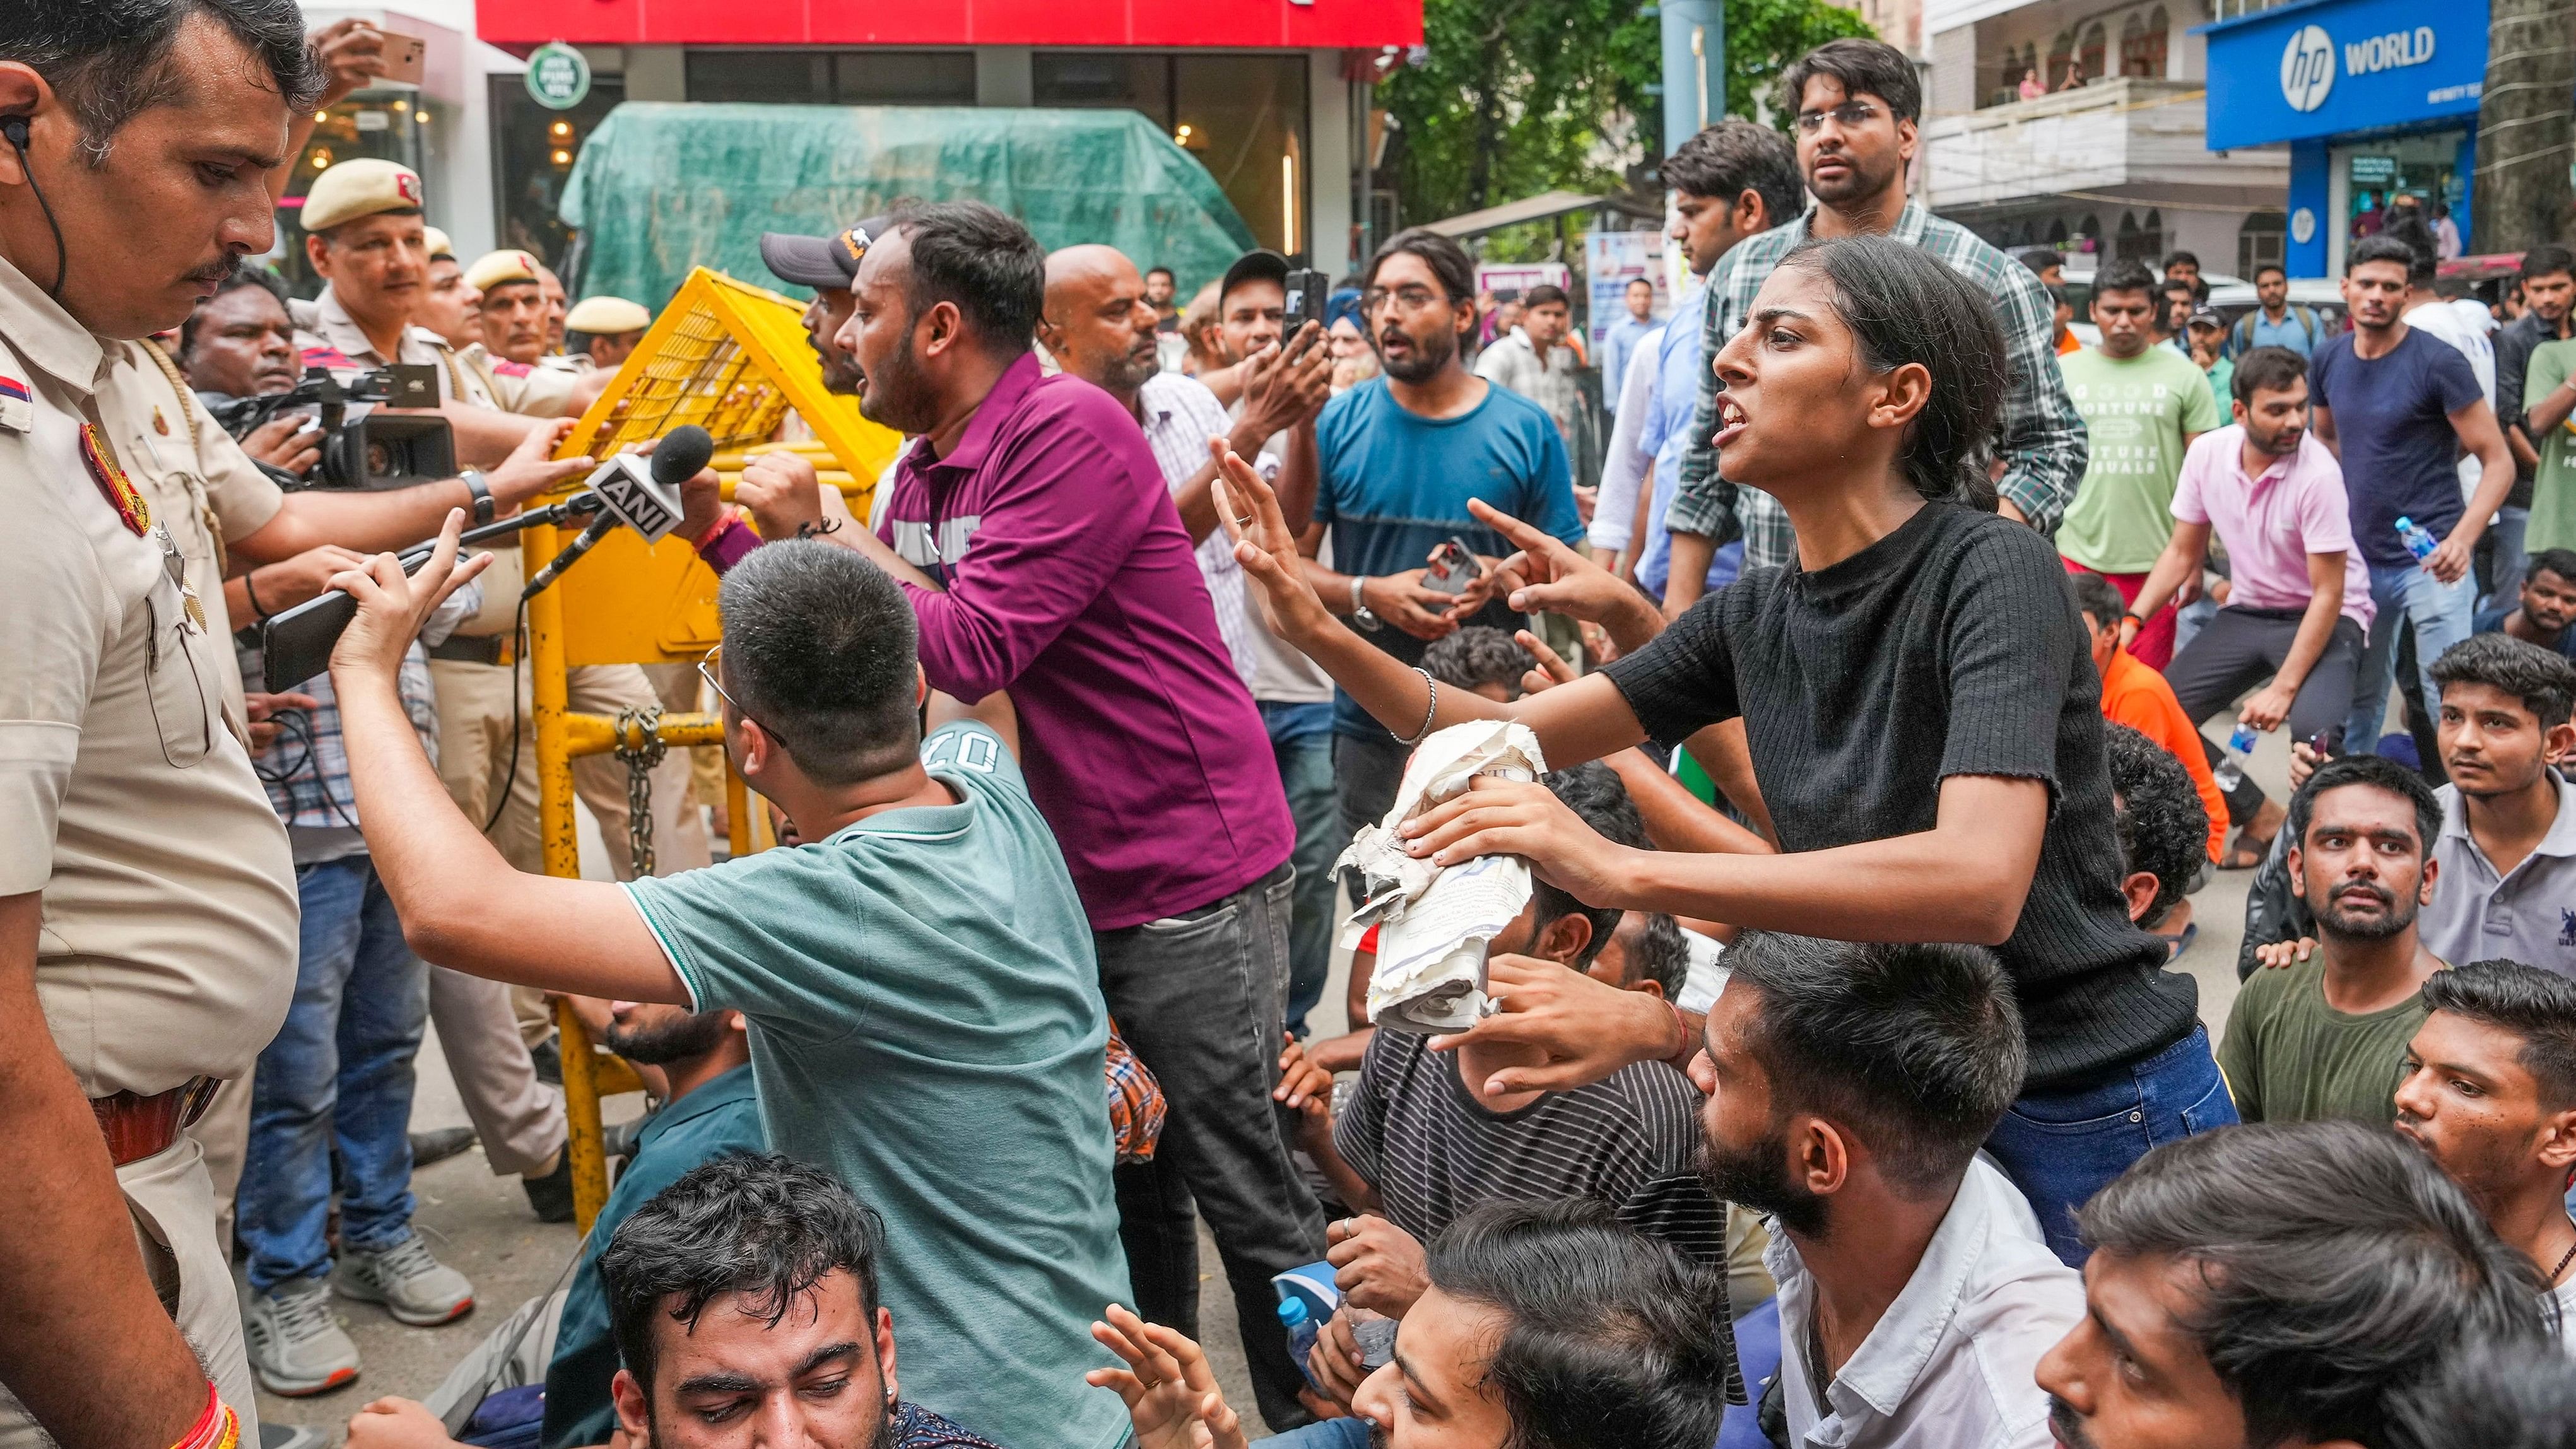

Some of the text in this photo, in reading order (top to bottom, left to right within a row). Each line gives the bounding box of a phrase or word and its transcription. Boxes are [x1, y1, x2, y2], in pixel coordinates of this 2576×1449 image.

[2285, 26, 2435, 112] hp WORLD
[2088, 445, 2158, 459] UTURE
[603, 478, 666, 532] ANI
